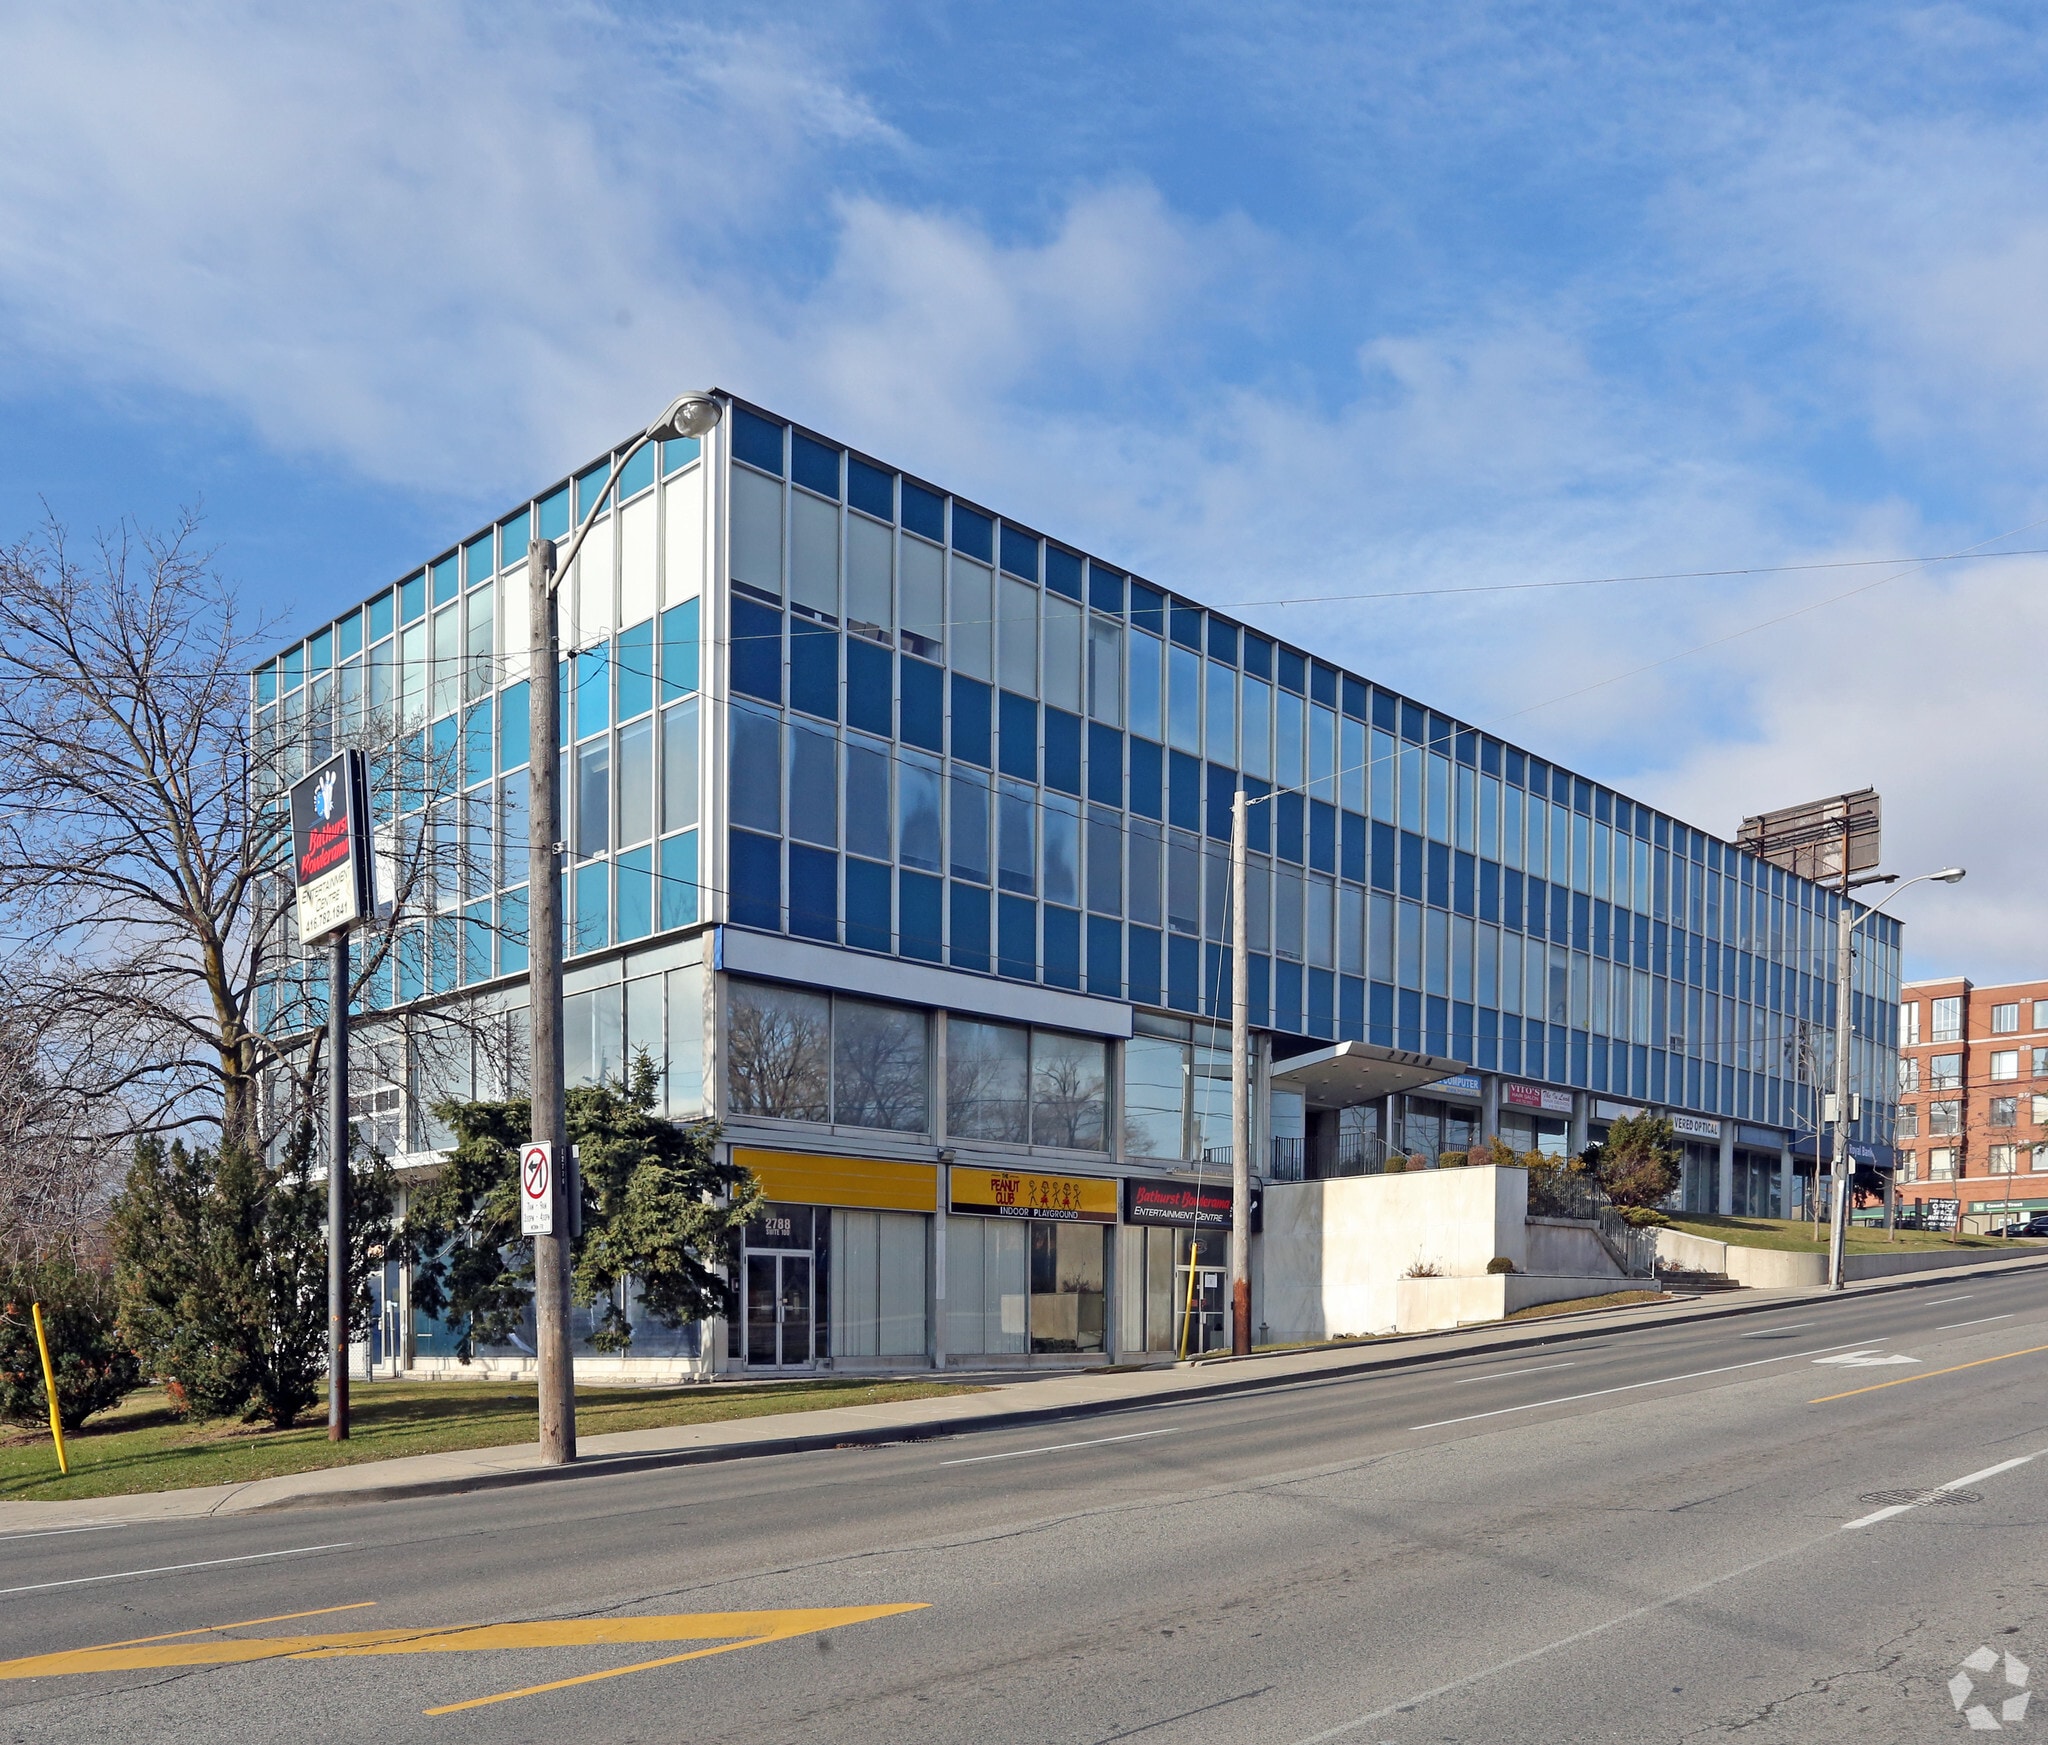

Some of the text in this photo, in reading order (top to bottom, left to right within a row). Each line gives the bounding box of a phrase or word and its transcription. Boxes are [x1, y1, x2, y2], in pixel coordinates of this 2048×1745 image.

[309, 815, 349, 857] Bathurst
[301, 838, 349, 882] Bowlerama
[302, 865, 351, 904] ENTERTAINMENT
[316, 889, 340, 912] CENTRE
[1386, 1050, 1433, 1066] 2788
[1443, 1077, 1479, 1089] COMPUTER
[1510, 1084, 1541, 1097] VITO'S
[1674, 1116, 1718, 1135] VERED OPTICAL
[991, 1178, 1020, 1193] PEANUT
[995, 1191, 1015, 1205] CLUB
[1136, 1186, 1231, 1209] Bathurst Bowlerama
[1000, 1206, 1079, 1219] INDOOR PLAYGROUND
[1134, 1206, 1224, 1222] ENTERTAINMENT CENTRE
[765, 1217, 791, 1230] 2788
